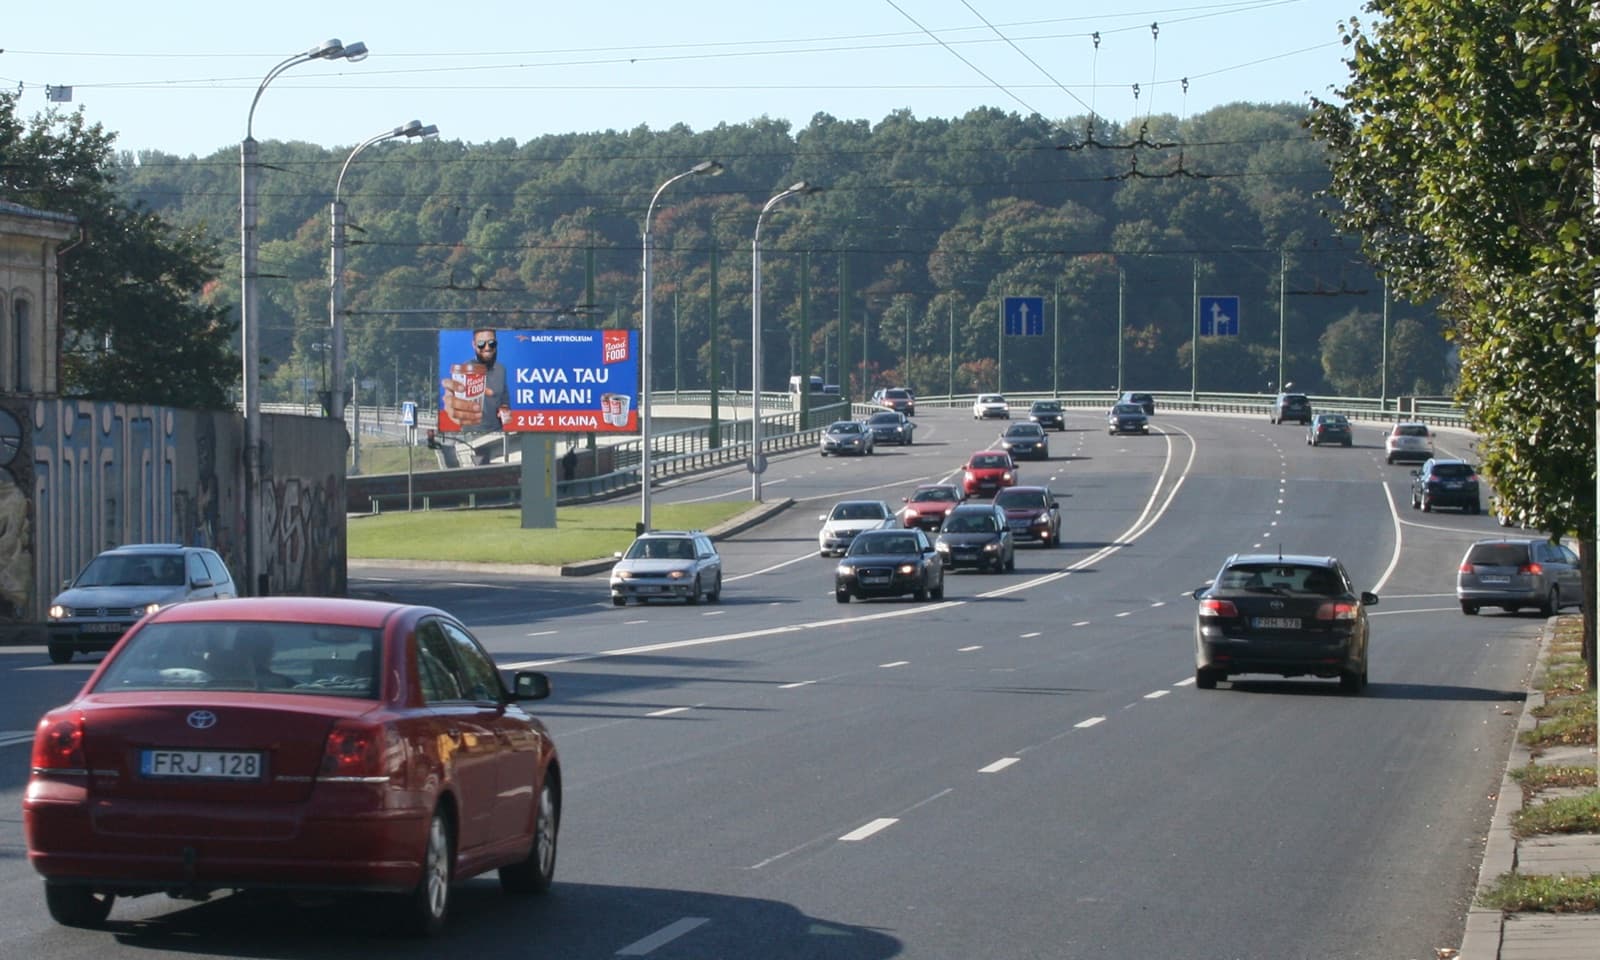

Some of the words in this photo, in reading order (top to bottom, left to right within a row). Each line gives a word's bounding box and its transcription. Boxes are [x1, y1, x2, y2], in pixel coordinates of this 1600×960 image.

[606, 348, 626, 361] FOOD
[516, 368, 568, 383] KAVA
[573, 368, 609, 383] TAU
[516, 388, 534, 404] IR
[540, 388, 592, 404] MAN!
[517, 415, 525, 426] 2
[528, 412, 545, 426] UŽ
[548, 415, 554, 426] 1
[558, 415, 598, 430] KAINĄ
[153, 752, 202, 773] FRJ
[219, 755, 257, 775] 128
